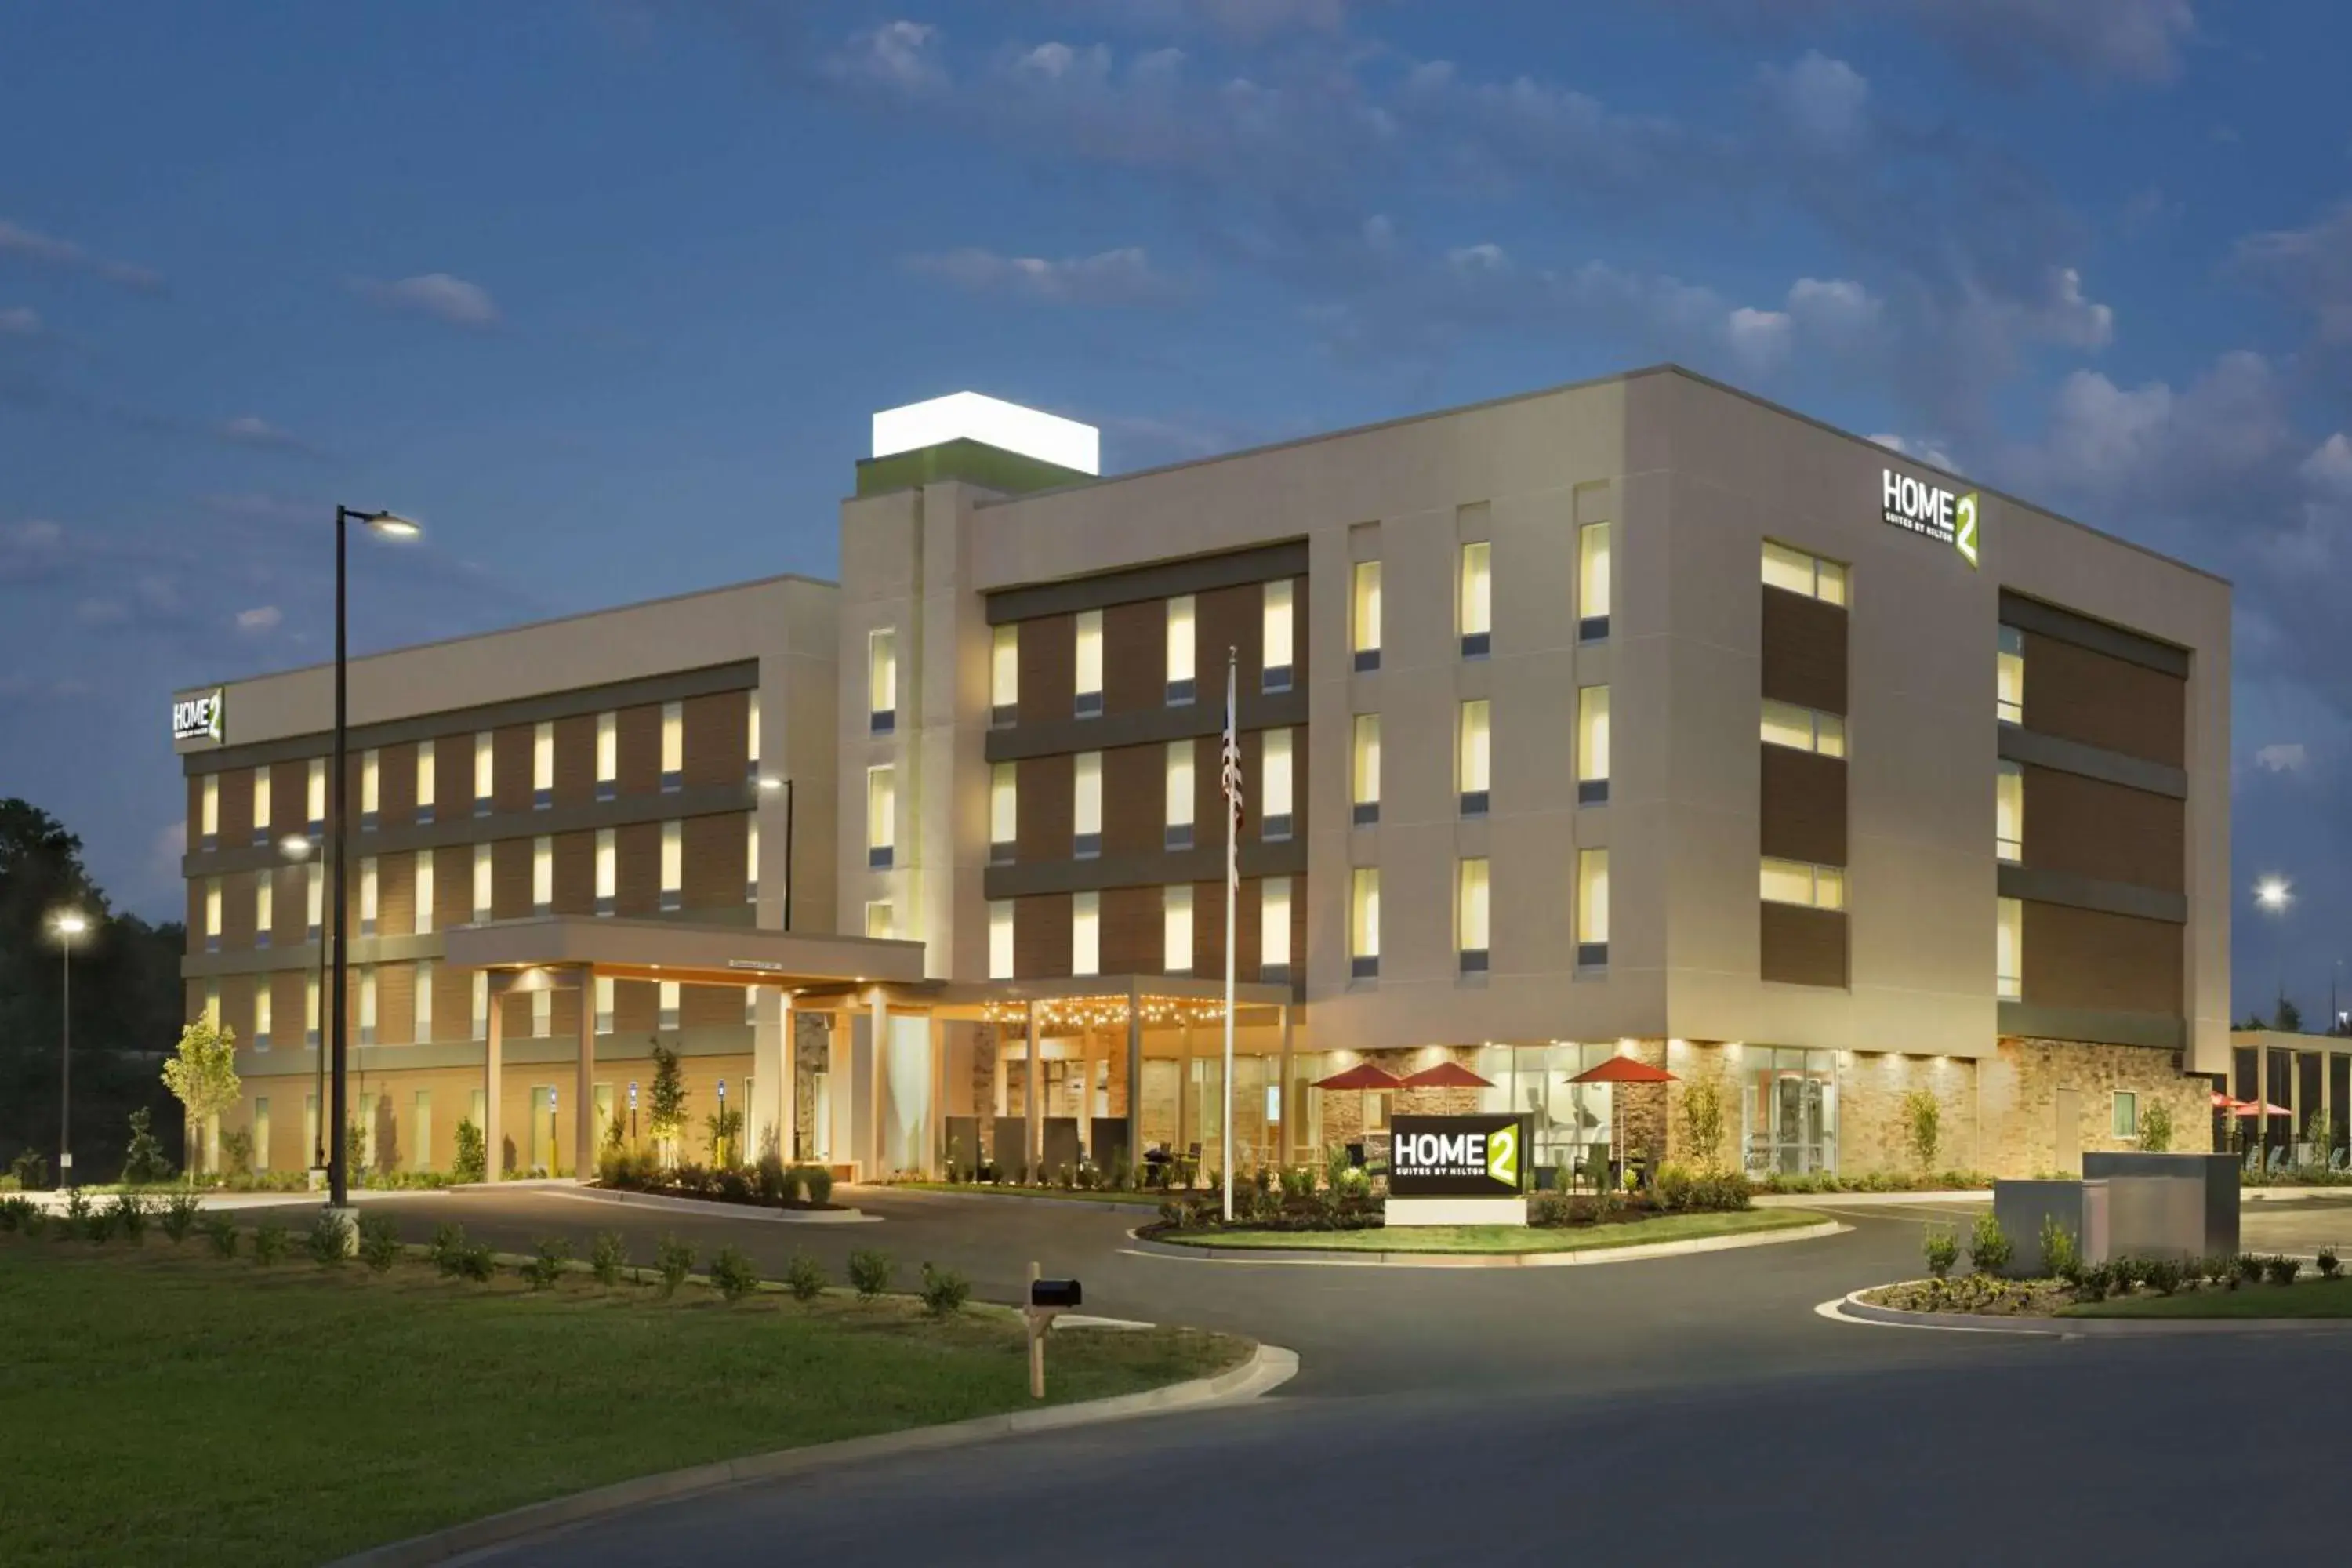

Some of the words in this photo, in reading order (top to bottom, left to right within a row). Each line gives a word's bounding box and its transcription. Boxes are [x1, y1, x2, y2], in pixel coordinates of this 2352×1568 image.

[1883, 468, 1955, 532] HOME
[174, 699, 209, 731] HOME
[1395, 1134, 1485, 1165] HOME
[1396, 1167, 1430, 1176] SUITES
[1450, 1167, 1486, 1176] HILTON
